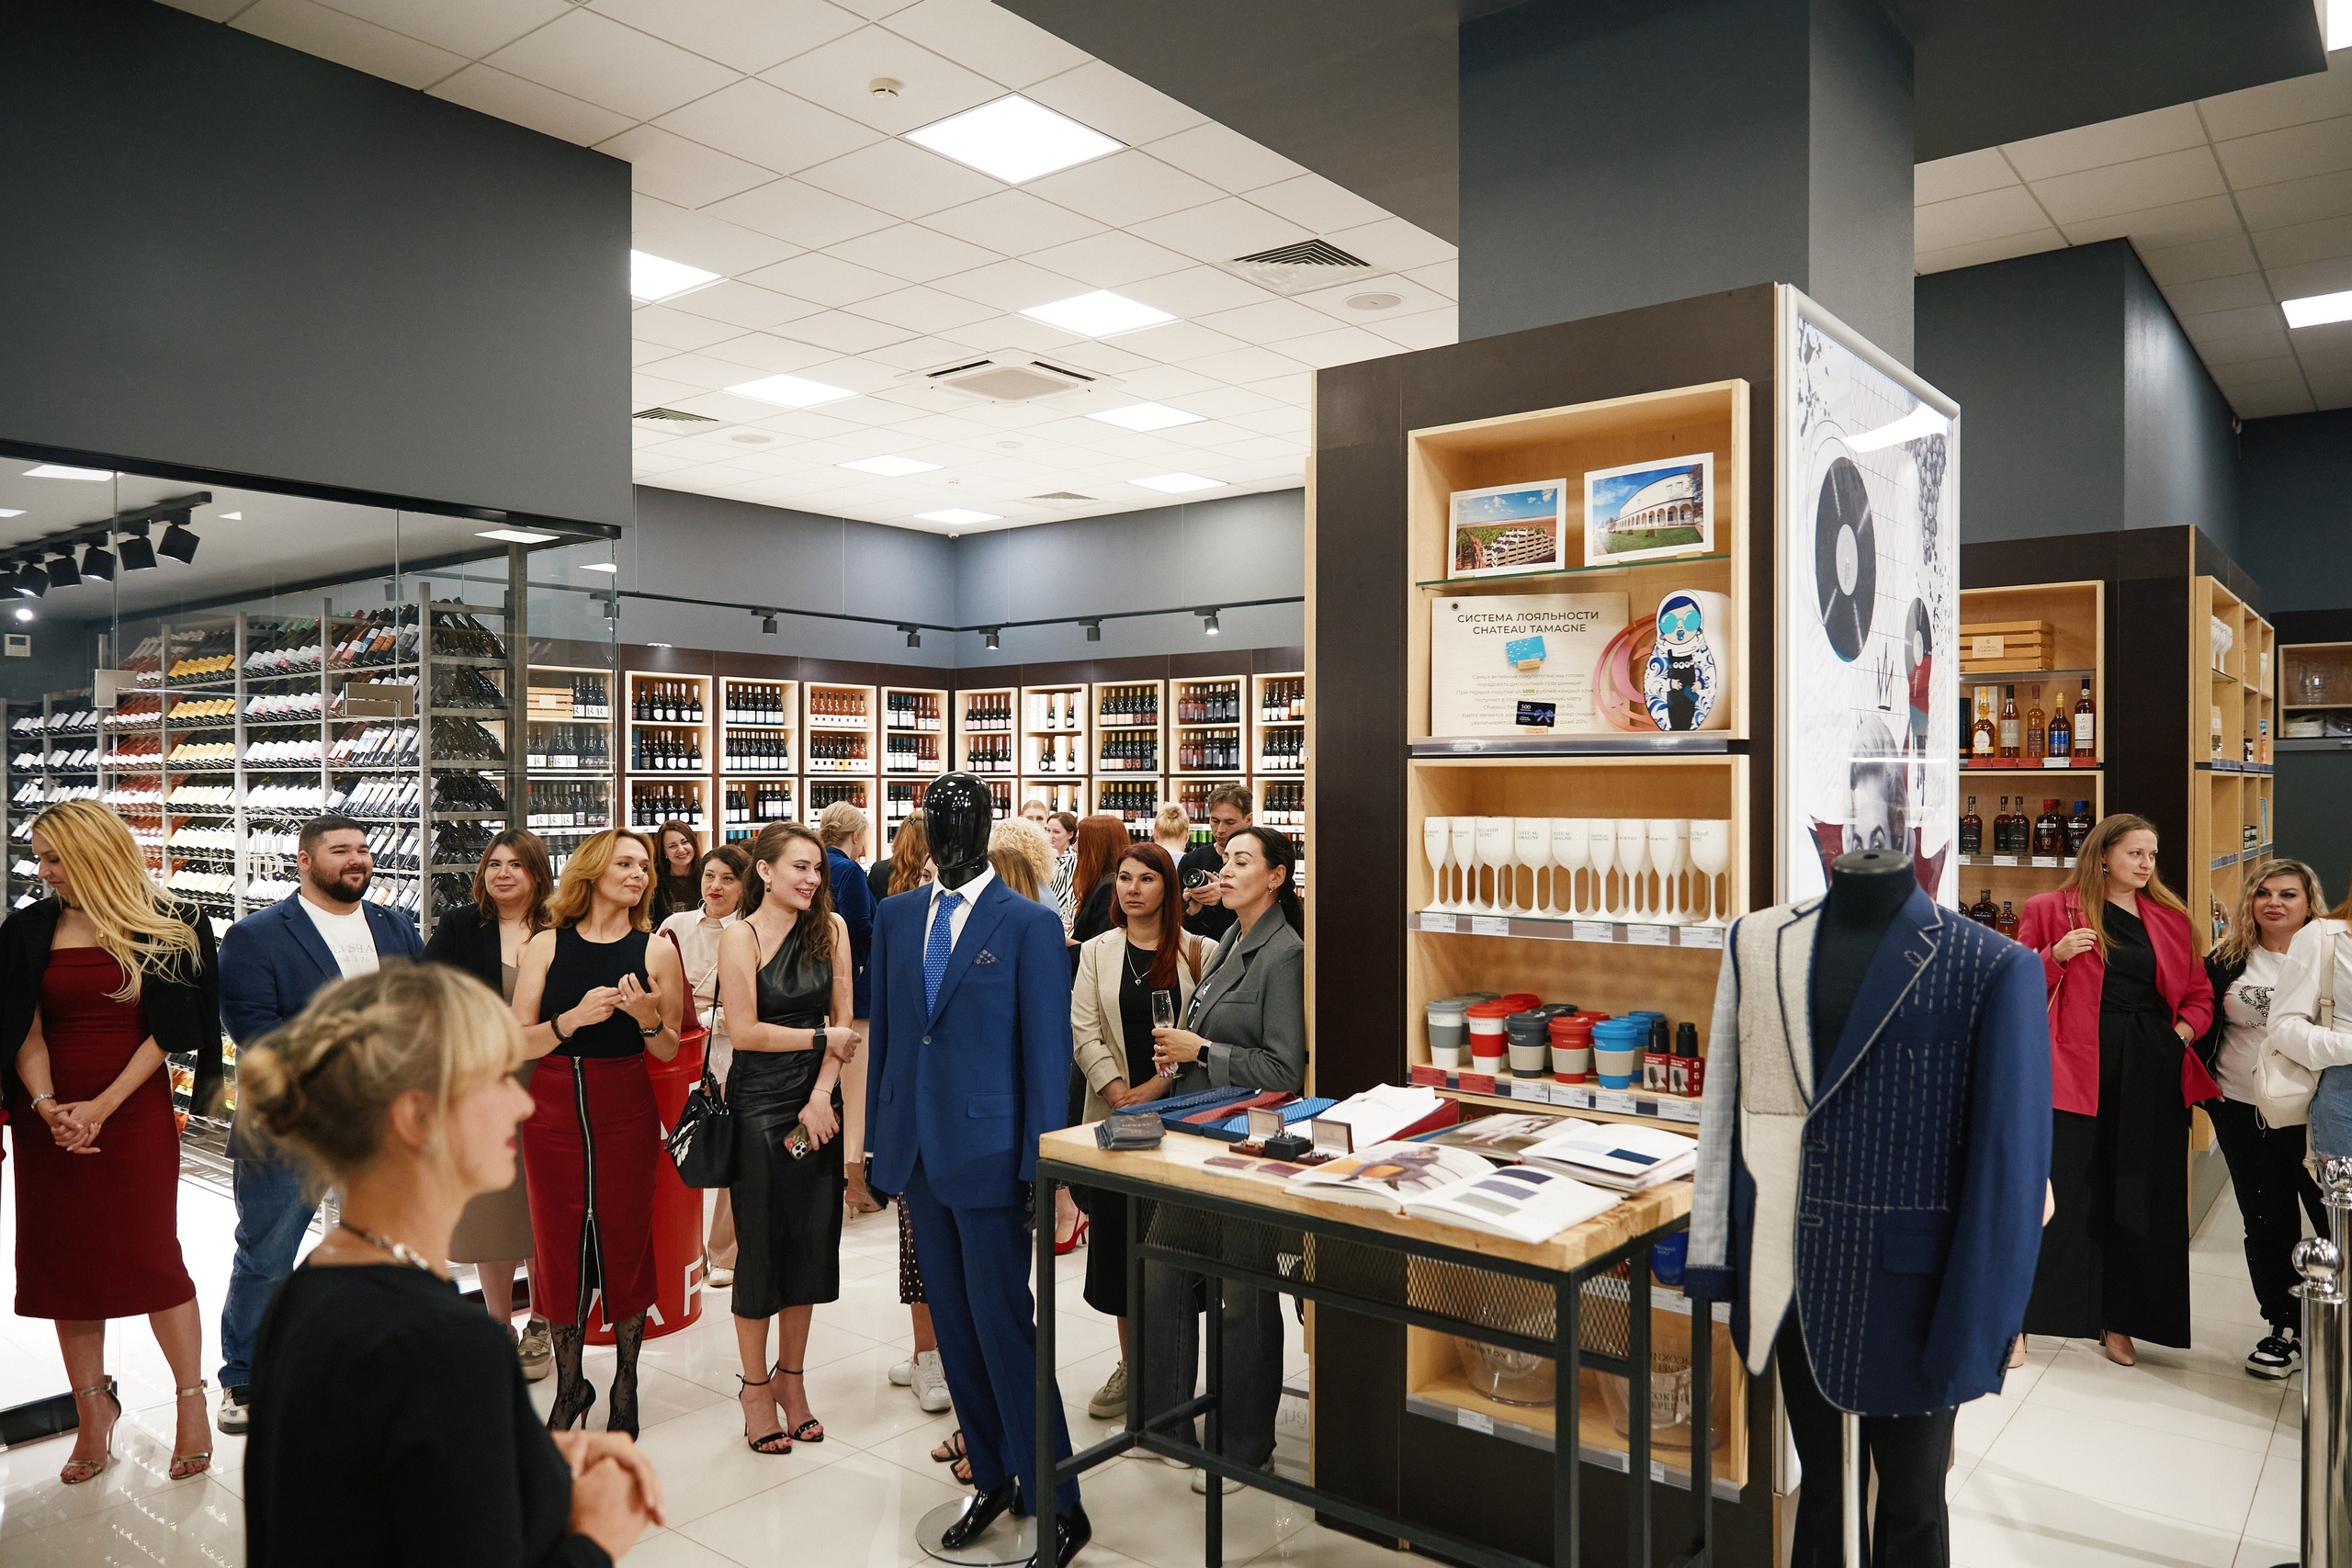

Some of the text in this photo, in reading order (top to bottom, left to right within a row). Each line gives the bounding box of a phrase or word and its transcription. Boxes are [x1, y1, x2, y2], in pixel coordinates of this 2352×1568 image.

[1457, 611, 1599, 623] СИСТЕМА ЛОЯЛЬНОСТИ
[1473, 624, 1587, 635] CHATEAU TAMAGNE
[1464, 1340, 1508, 1359] ARISTOV
